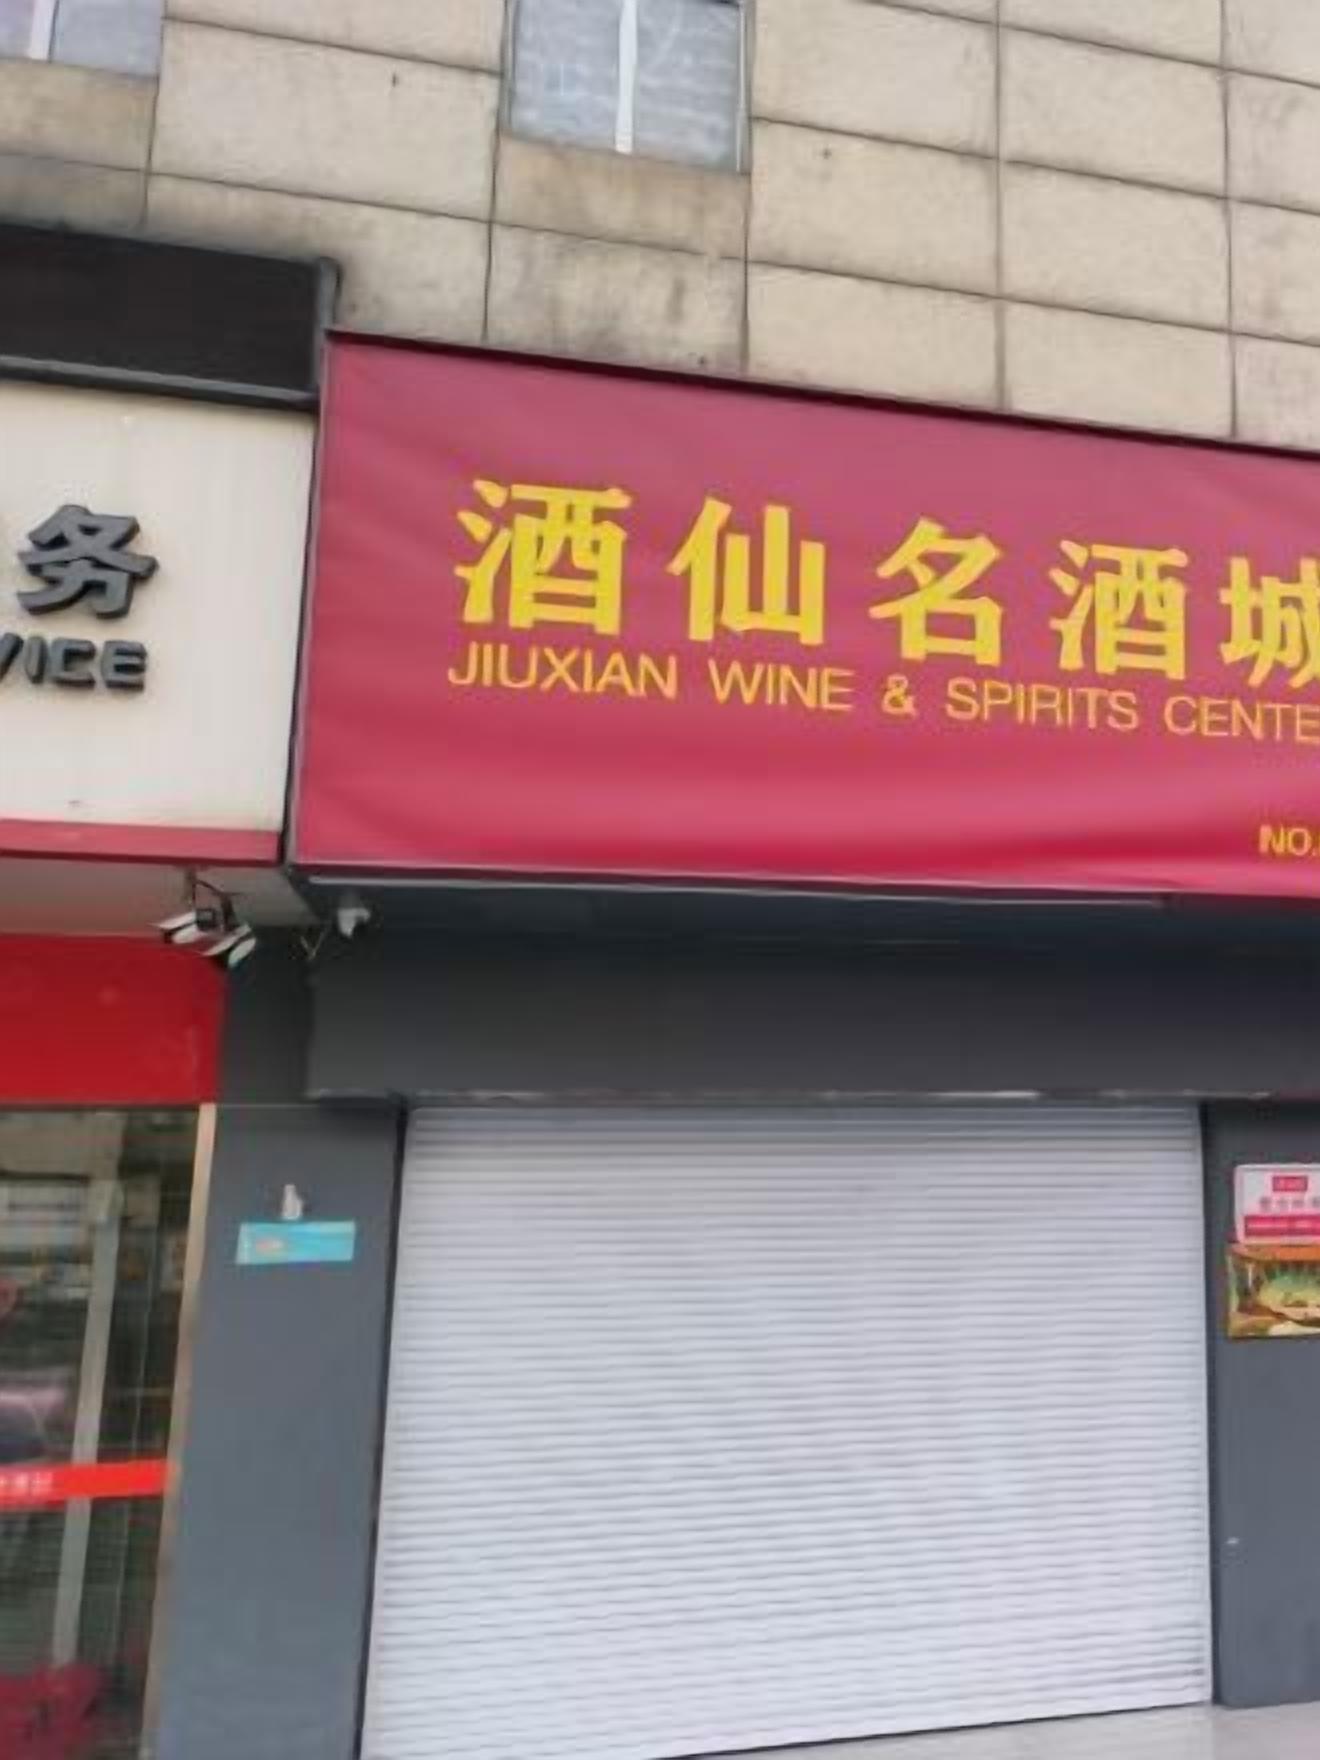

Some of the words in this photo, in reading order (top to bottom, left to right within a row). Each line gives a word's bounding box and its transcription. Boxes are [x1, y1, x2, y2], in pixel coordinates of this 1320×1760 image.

[16, 504, 159, 620] 务
[448, 641, 677, 699] JIUXIAN
[708, 658, 855, 712] WINE
[881, 674, 917, 717] &
[945, 677, 1139, 732] SPIRITS
